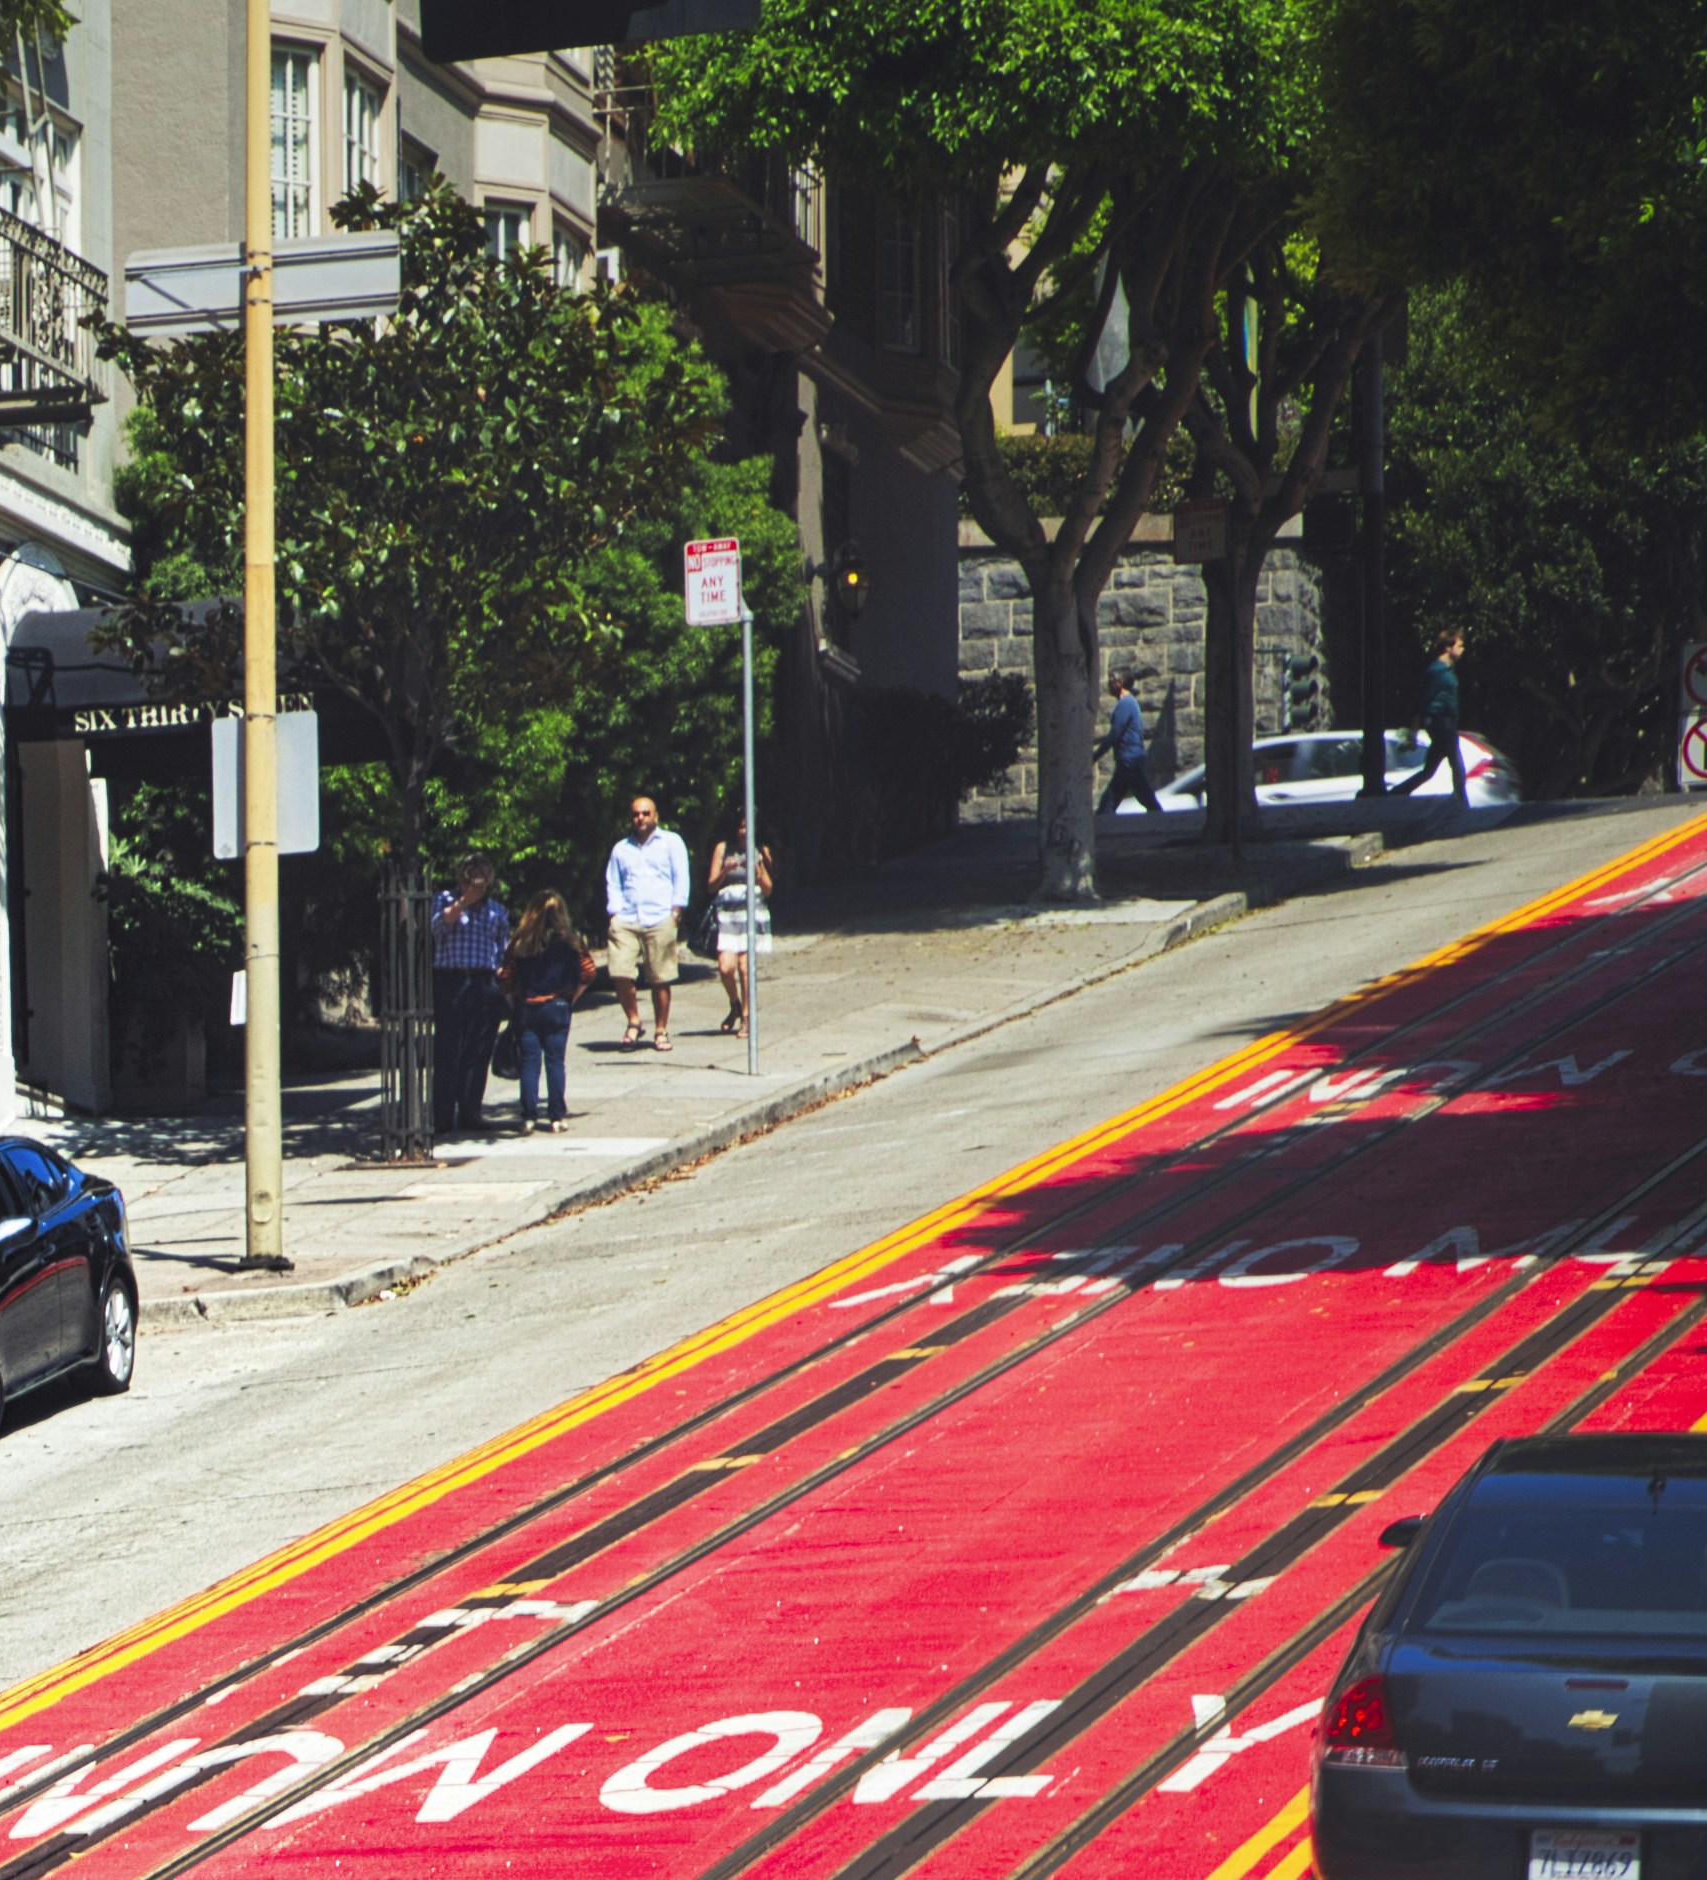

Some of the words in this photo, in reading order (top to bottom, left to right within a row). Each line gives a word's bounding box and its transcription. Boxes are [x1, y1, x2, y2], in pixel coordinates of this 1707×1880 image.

[703, 555, 736, 567] STOPPING
[701, 575, 724, 588] ANY
[700, 590, 727, 604] TIME
[74, 709, 117, 732] SIX
[228, 691, 316, 720] SEN
[828, 1235, 1361, 1309] ONLY
[598, 1697, 1325, 1816] ONLY
